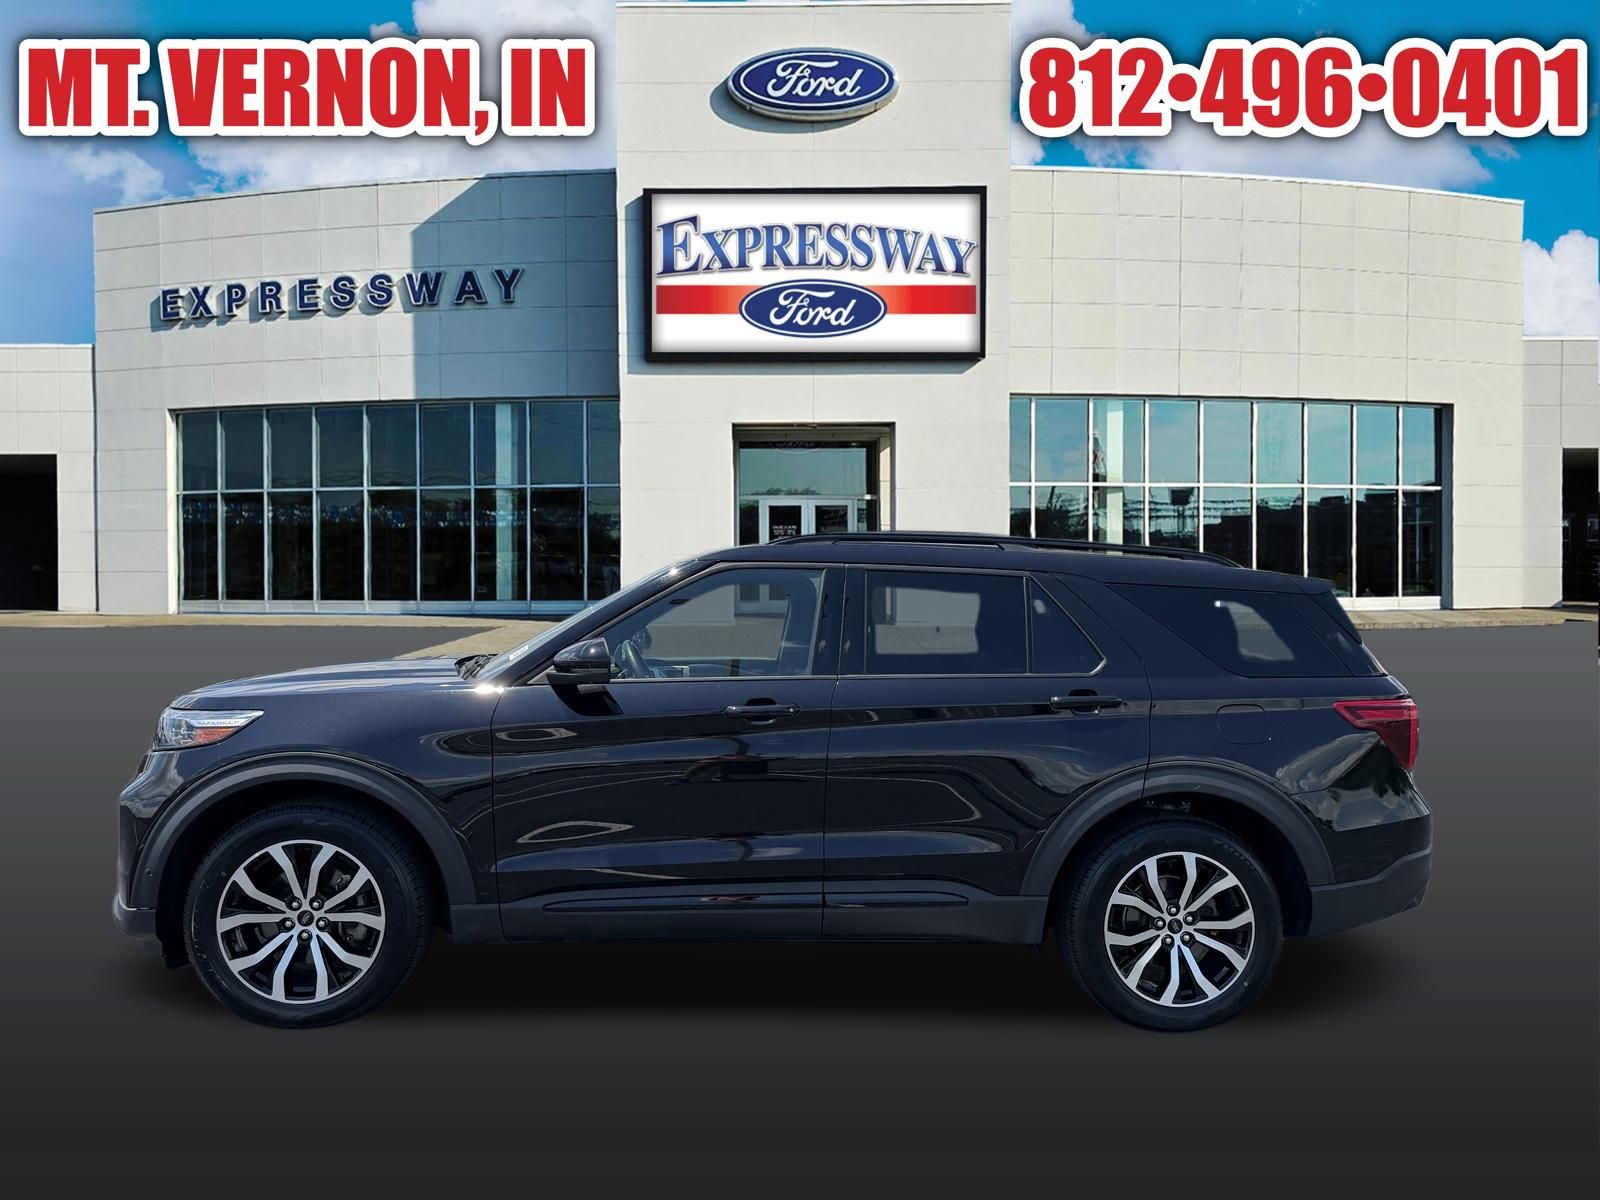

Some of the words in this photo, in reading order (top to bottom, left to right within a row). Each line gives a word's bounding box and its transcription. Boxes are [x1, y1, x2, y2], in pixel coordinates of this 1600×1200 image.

[766, 59, 864, 98] Ford
[655, 214, 978, 279] EXPRESSWAY
[159, 267, 524, 321] EXPRESSWAY
[769, 288, 858, 326] Ford
